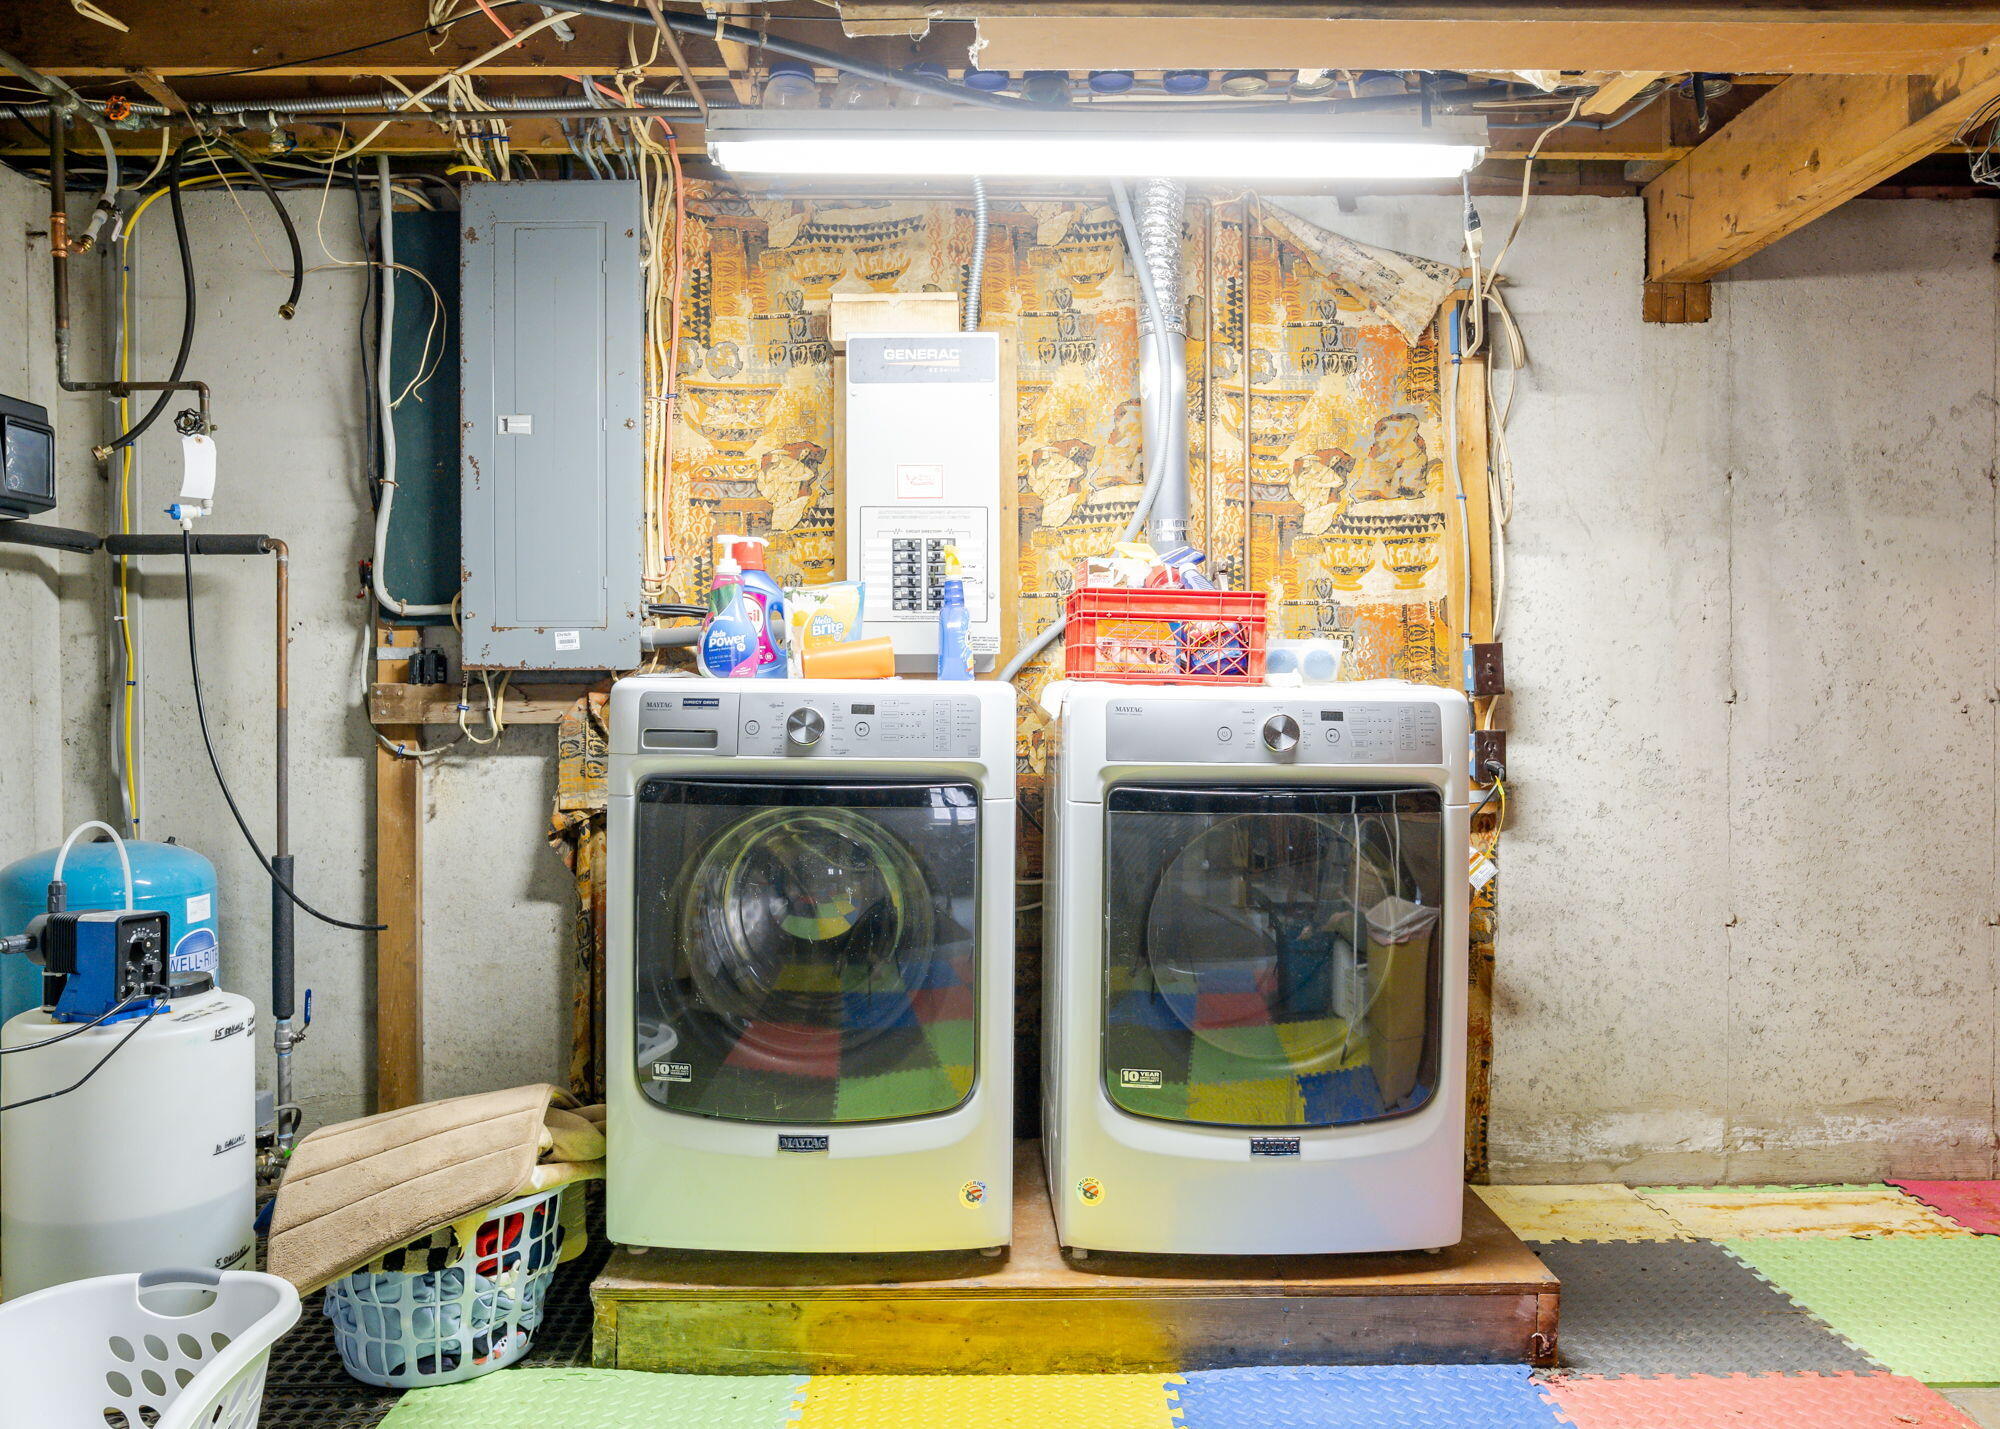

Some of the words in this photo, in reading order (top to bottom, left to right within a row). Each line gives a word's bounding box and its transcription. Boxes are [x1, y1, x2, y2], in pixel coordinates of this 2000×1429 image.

[884, 349, 960, 360] GENERAC
[812, 622, 844, 636] Brite
[214, 1027, 224, 1039] 15
[654, 1063, 670, 1075] 10
[1123, 1070, 1139, 1082] 10
[781, 1138, 826, 1148] MAYTAG
[1252, 1141, 1297, 1151] MAYTAG
[961, 1180, 986, 1193] AMERICA
[215, 1257, 222, 1268] 5
